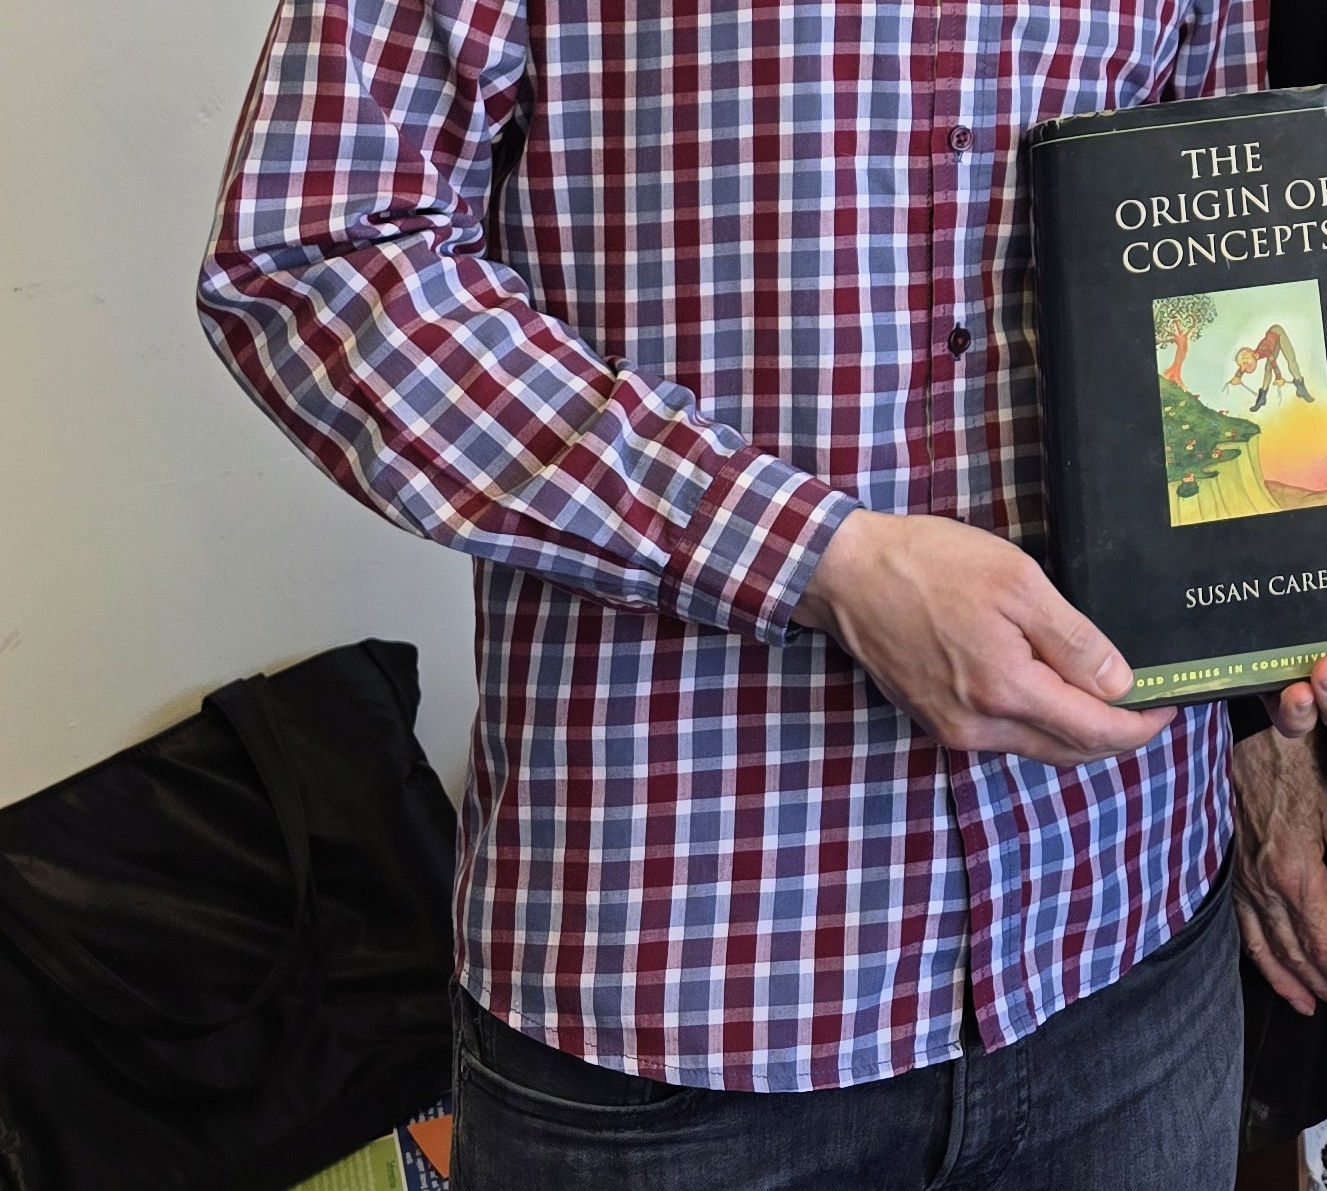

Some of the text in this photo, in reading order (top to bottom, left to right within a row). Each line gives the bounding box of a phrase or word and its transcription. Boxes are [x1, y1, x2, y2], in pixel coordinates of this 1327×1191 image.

[1181, 141, 1263, 179] THE
[1115, 184, 1270, 230] ORIGIN
[1185, 579, 1260, 609] SUSAN
[1136, 676, 1165, 688] ORD
[1173, 667, 1220, 683] SERIES
[1228, 663, 1243, 675] IN
